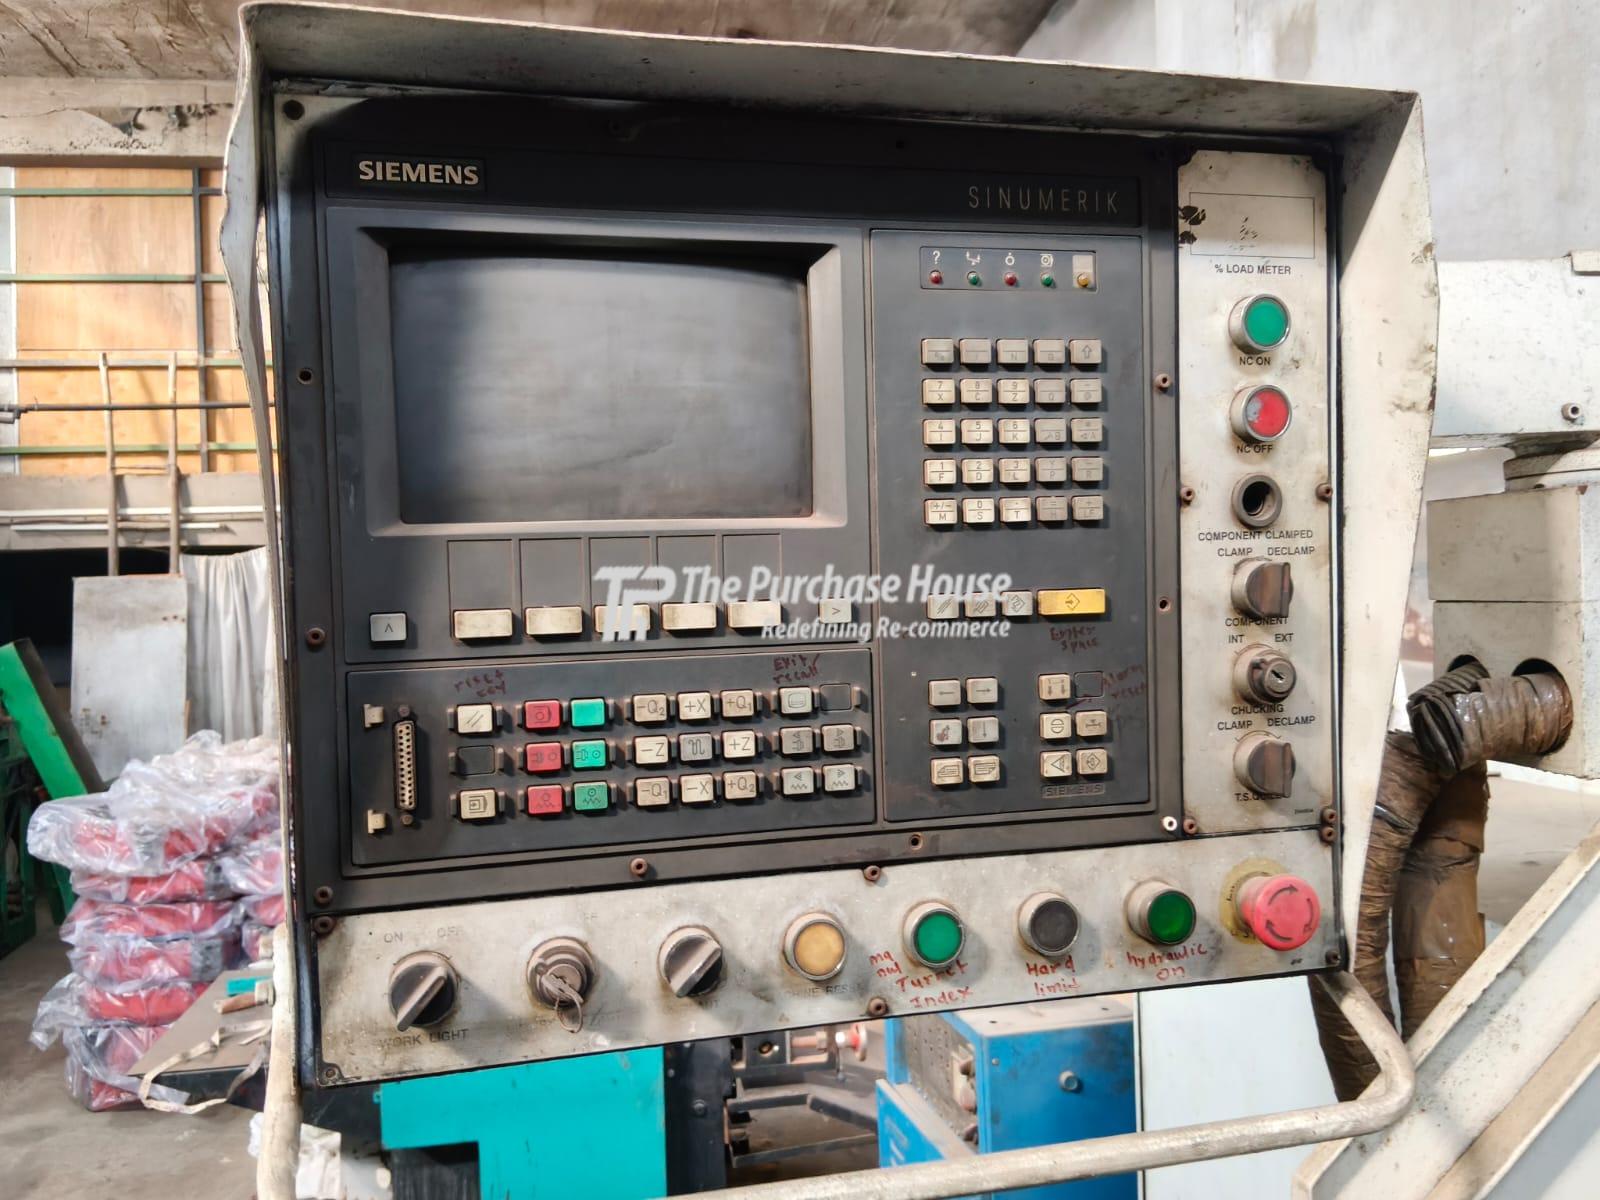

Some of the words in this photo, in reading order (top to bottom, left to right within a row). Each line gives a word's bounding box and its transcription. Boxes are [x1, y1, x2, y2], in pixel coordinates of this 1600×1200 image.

[359, 160, 479, 185] SIEMENS
[968, 185, 1119, 213] SINUMERIK
[1214, 263, 1224, 273] %
[1226, 263, 1255, 274] LOAD
[1257, 264, 1292, 275] METER
[1240, 356, 1254, 366] NC
[1256, 356, 1271, 366] ON
[1236, 444, 1251, 454] NC
[1253, 444, 1273, 454] OFF
[1198, 531, 1262, 541] COMPONENT
[1264, 529, 1314, 540] CLAMPED
[1217, 547, 1253, 557] CLAMP
[1267, 546, 1316, 556] DECLAMP
[1225, 616, 1289, 627] COMPONENT
[1228, 634, 1244, 644] INT
[1275, 633, 1294, 643] EXT
[684, 697, 707, 714] +X
[1231, 704, 1284, 715] CHUCKING
[1217, 720, 1253, 730] CLAMP
[1267, 715, 1316, 727] DECLAMP
[641, 742, 665, 757] -Z
[729, 737, 751, 751] +Z
[686, 780, 710, 795] -X
[1126, 943, 1207, 967] hydraulic
[1026, 954, 1076, 977] Hard
[429, 1028, 469, 1043] LIGHT
